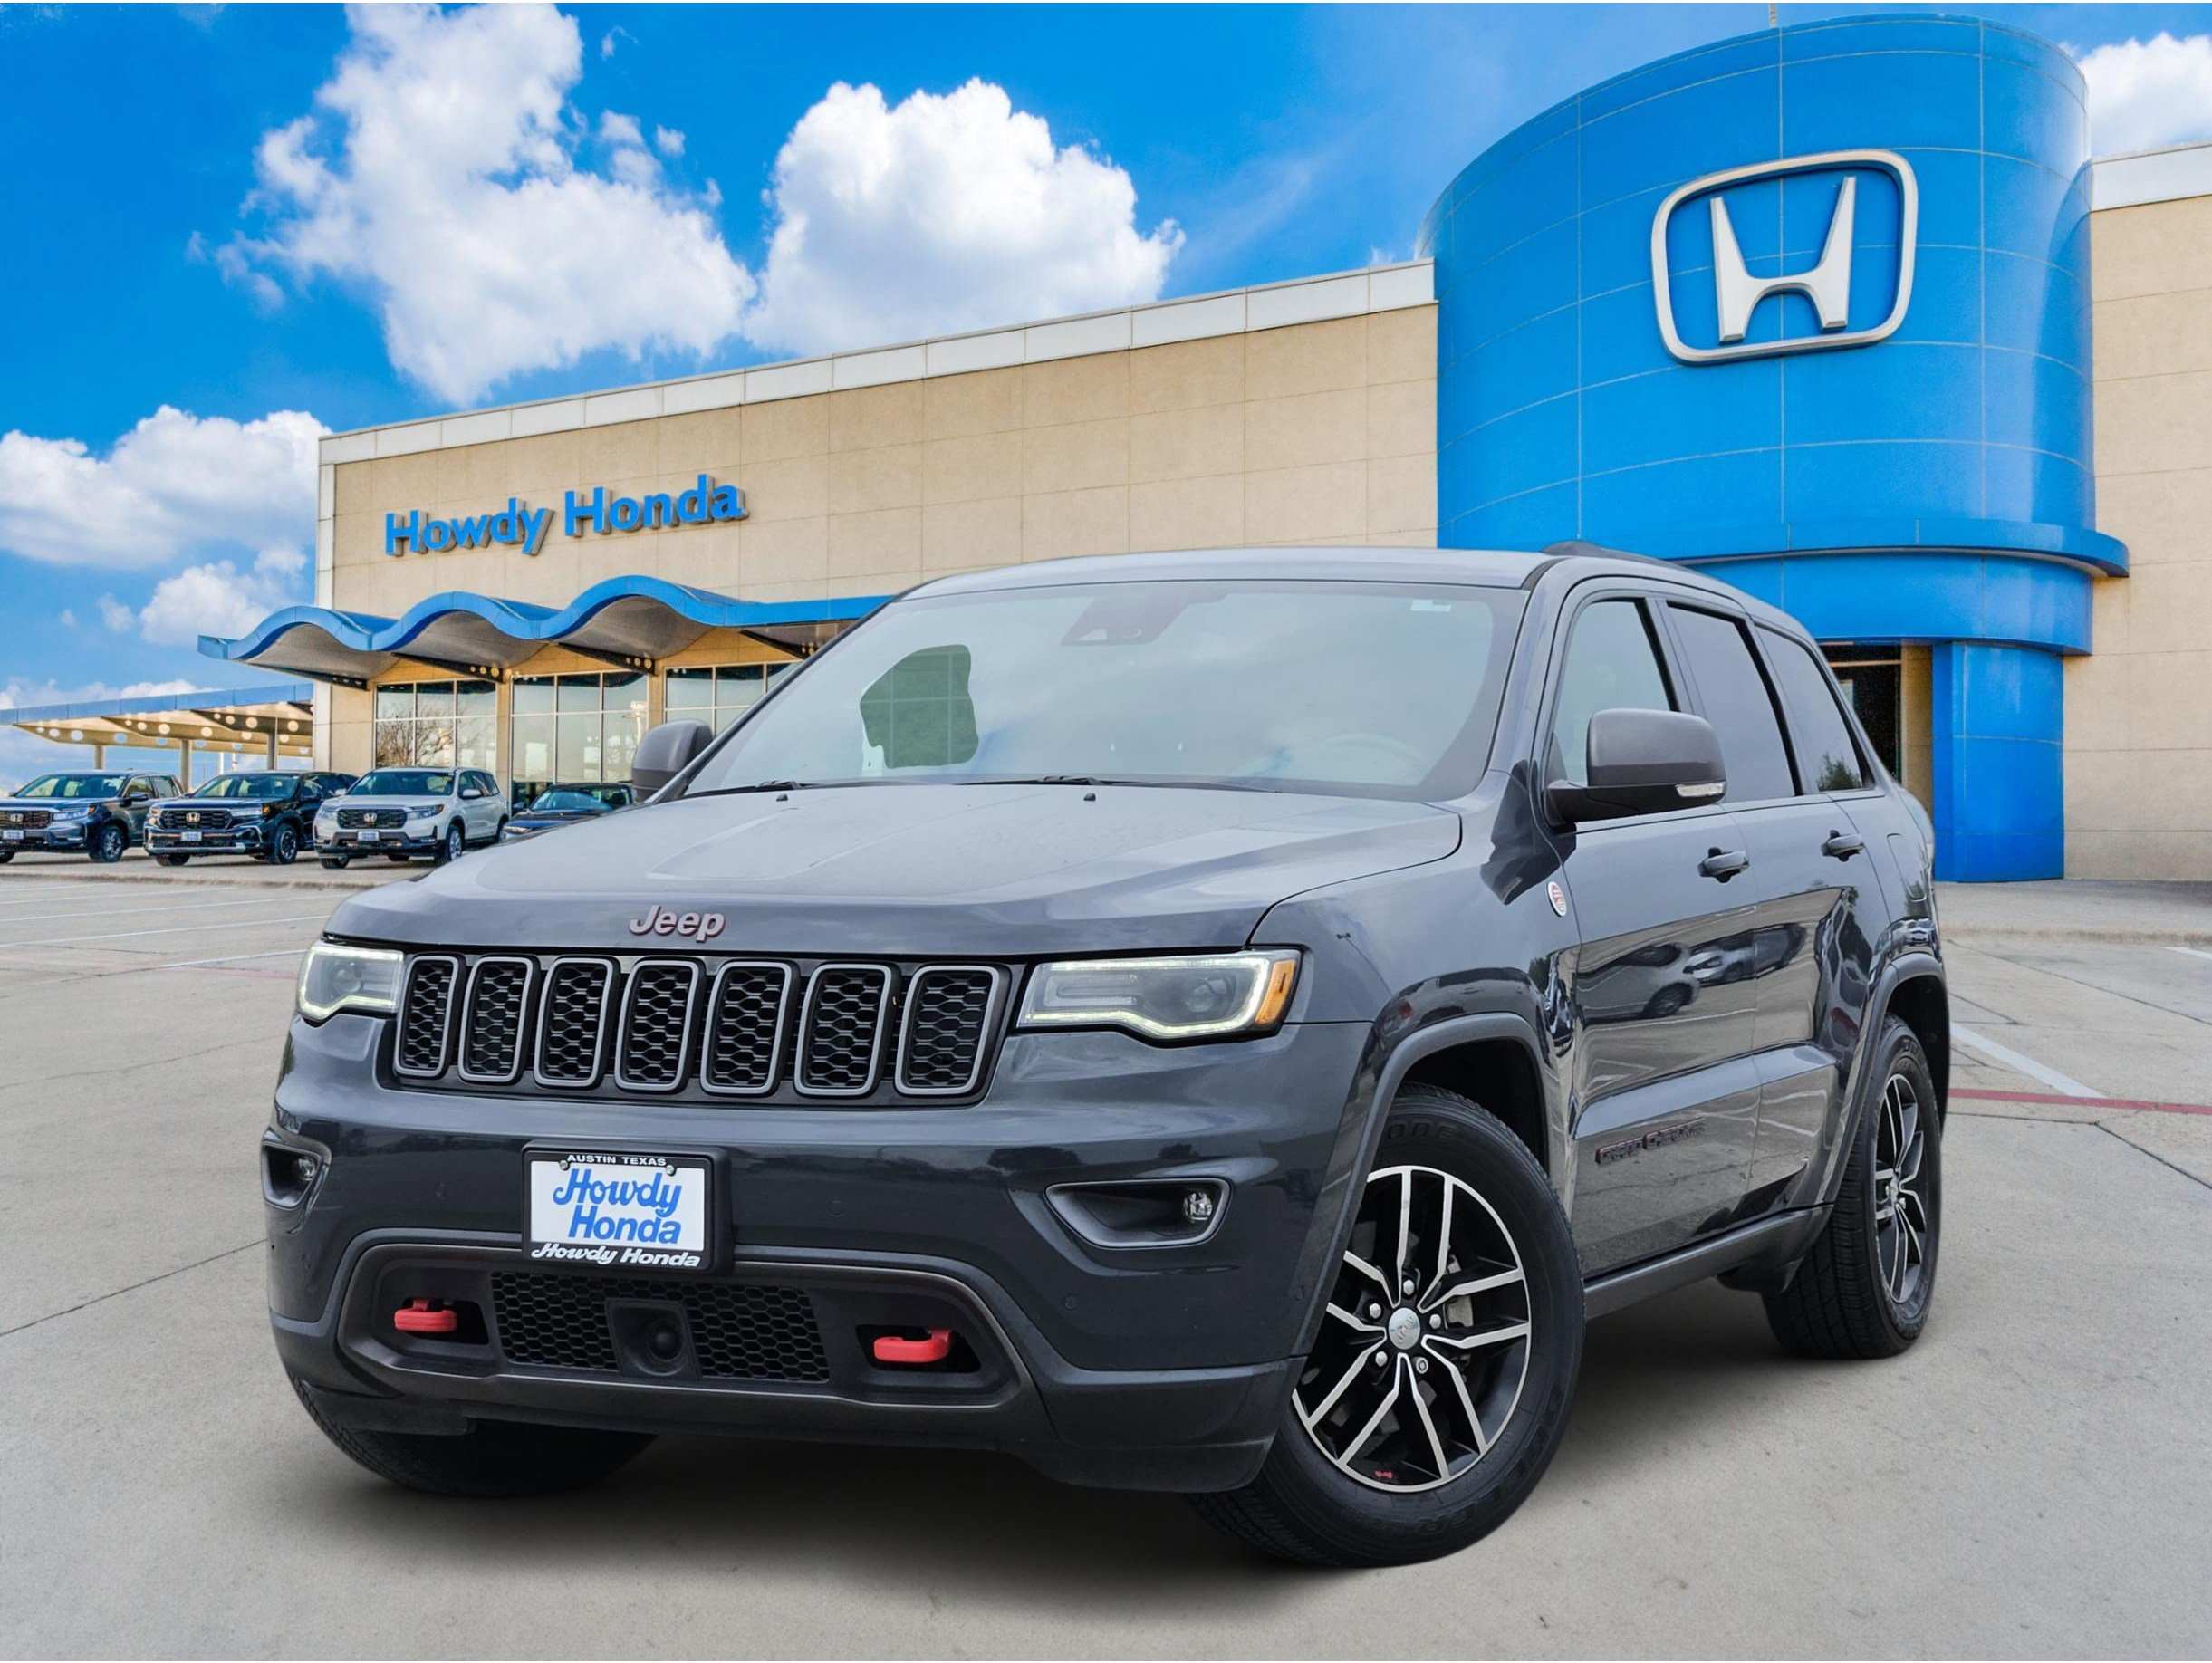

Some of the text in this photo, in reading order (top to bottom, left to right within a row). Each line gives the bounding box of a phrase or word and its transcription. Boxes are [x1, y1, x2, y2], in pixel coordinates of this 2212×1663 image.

[385, 474, 748, 556] Howdy Honda
[630, 905, 725, 943] Jeep
[567, 1154, 667, 1167] AUSTIN TEXAS
[553, 1168, 682, 1217] Howdy
[568, 1205, 681, 1245] Honda
[531, 1242, 701, 1267] Howdy Honda
